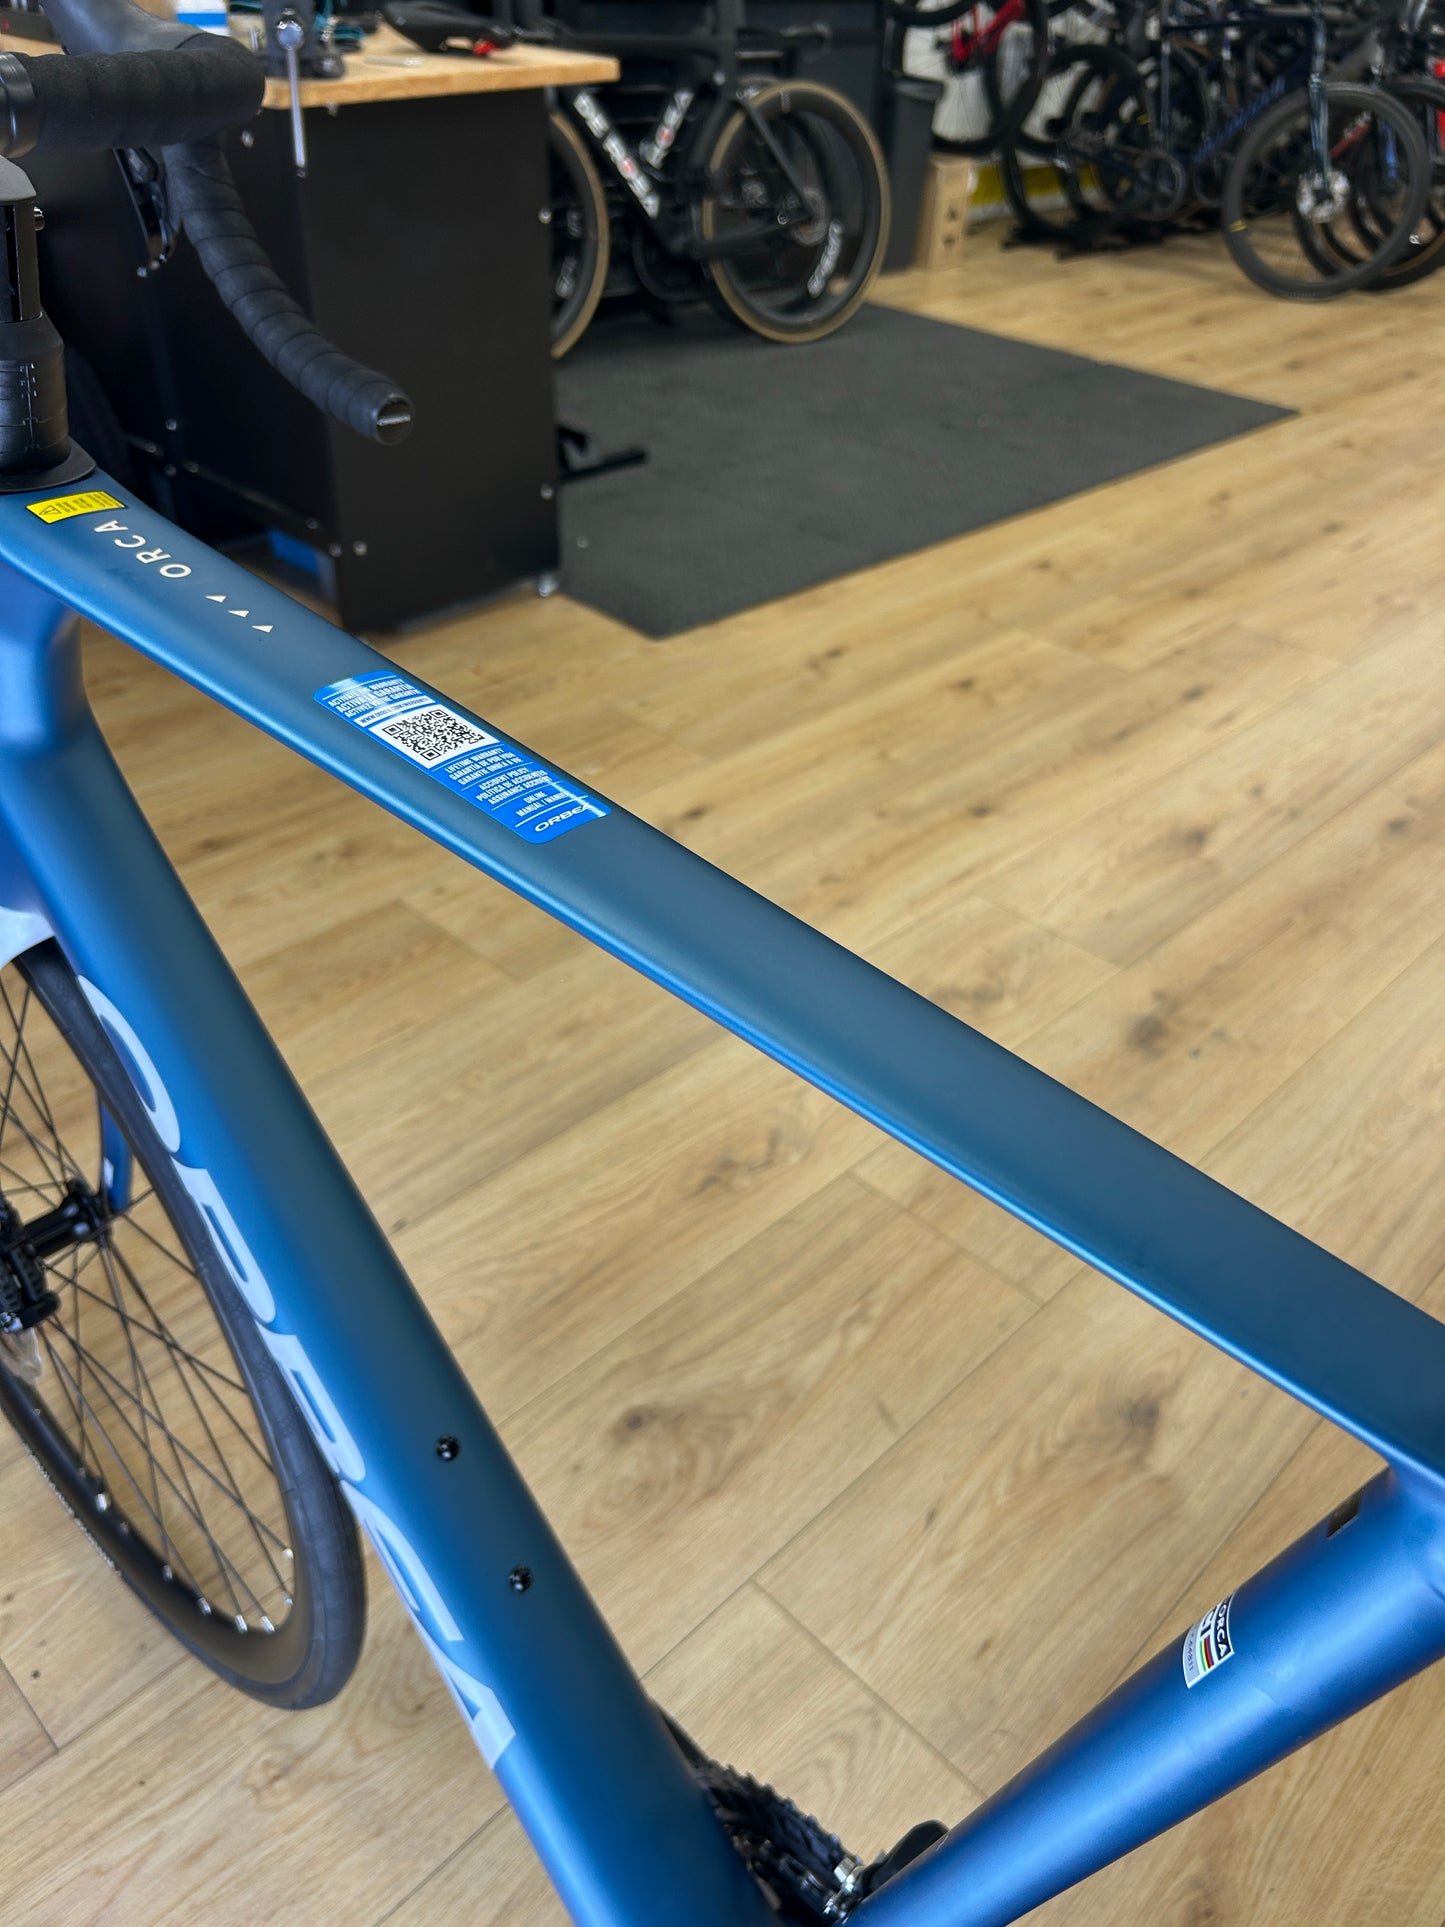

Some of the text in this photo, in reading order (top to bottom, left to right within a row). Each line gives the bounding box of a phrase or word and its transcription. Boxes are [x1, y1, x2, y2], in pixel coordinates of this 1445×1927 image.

[94, 520, 192, 578] ORCA
[328, 691, 358, 707] ACTIVATE
[335, 696, 365, 713] ACTIVA
[344, 702, 374, 718] ACTIVEZ
[444, 748, 504, 773] LIFETIME WARRANTY
[486, 755, 503, 763] POR
[499, 752, 516, 760] VIDA
[458, 768, 490, 785] GARANTIE
[487, 761, 509, 772] ORBEA
[479, 767, 530, 790] ACCIDENT POLICY
[476, 770, 548, 801] POLÍTICA DE ACCIDENTES
[488, 785, 526, 805] ASSURANCE
[523, 791, 547, 804] ONLINE
[516, 801, 544, 817] MANUAL
[534, 804, 591, 832] ORBEA
[1216, 1604, 1228, 1657] ORCA
